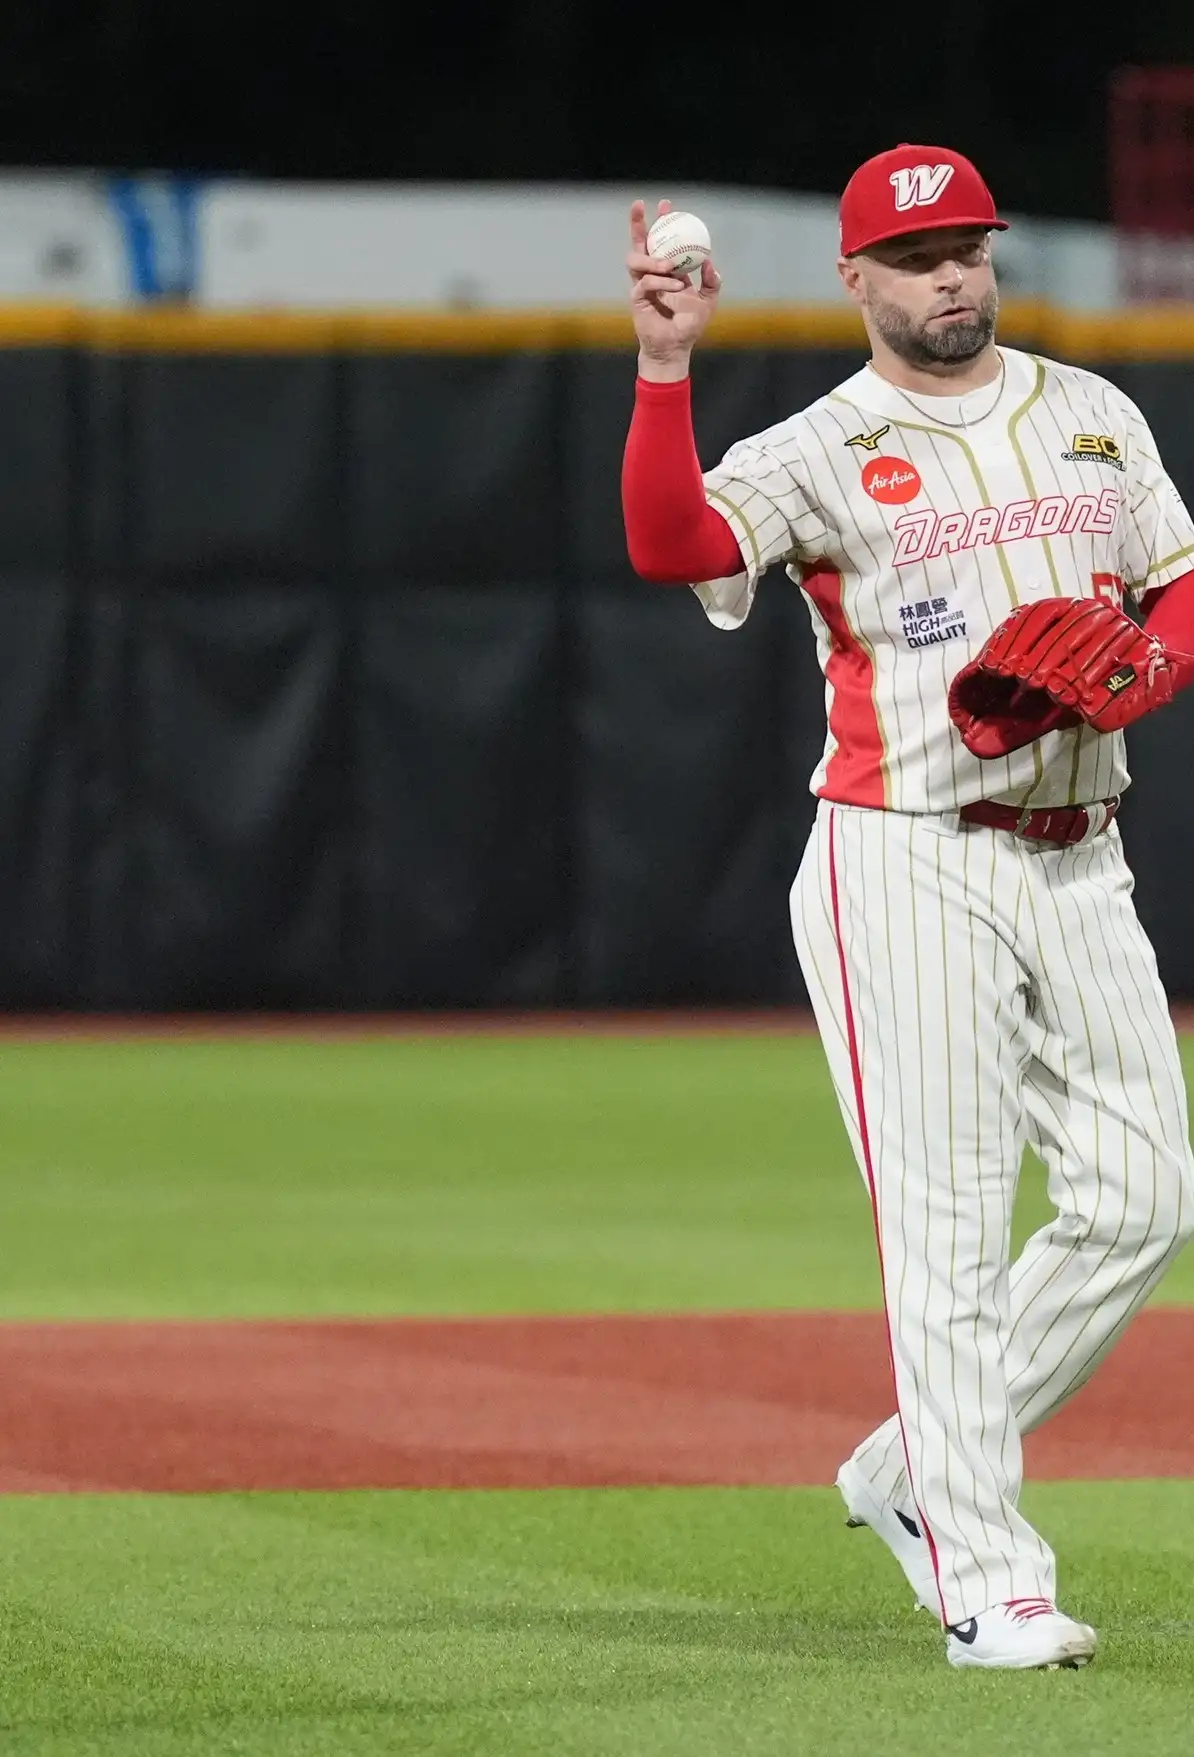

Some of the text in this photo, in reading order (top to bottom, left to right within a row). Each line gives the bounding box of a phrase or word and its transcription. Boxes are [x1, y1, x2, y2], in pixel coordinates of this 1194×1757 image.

[889, 164, 955, 211] W
[1072, 434, 1120, 459] BC
[892, 489, 1119, 567] DRAGONS
[899, 597, 948, 621] 林鳳營
[903, 617, 940, 636] HIGH
[907, 622, 967, 648] QUALITY
